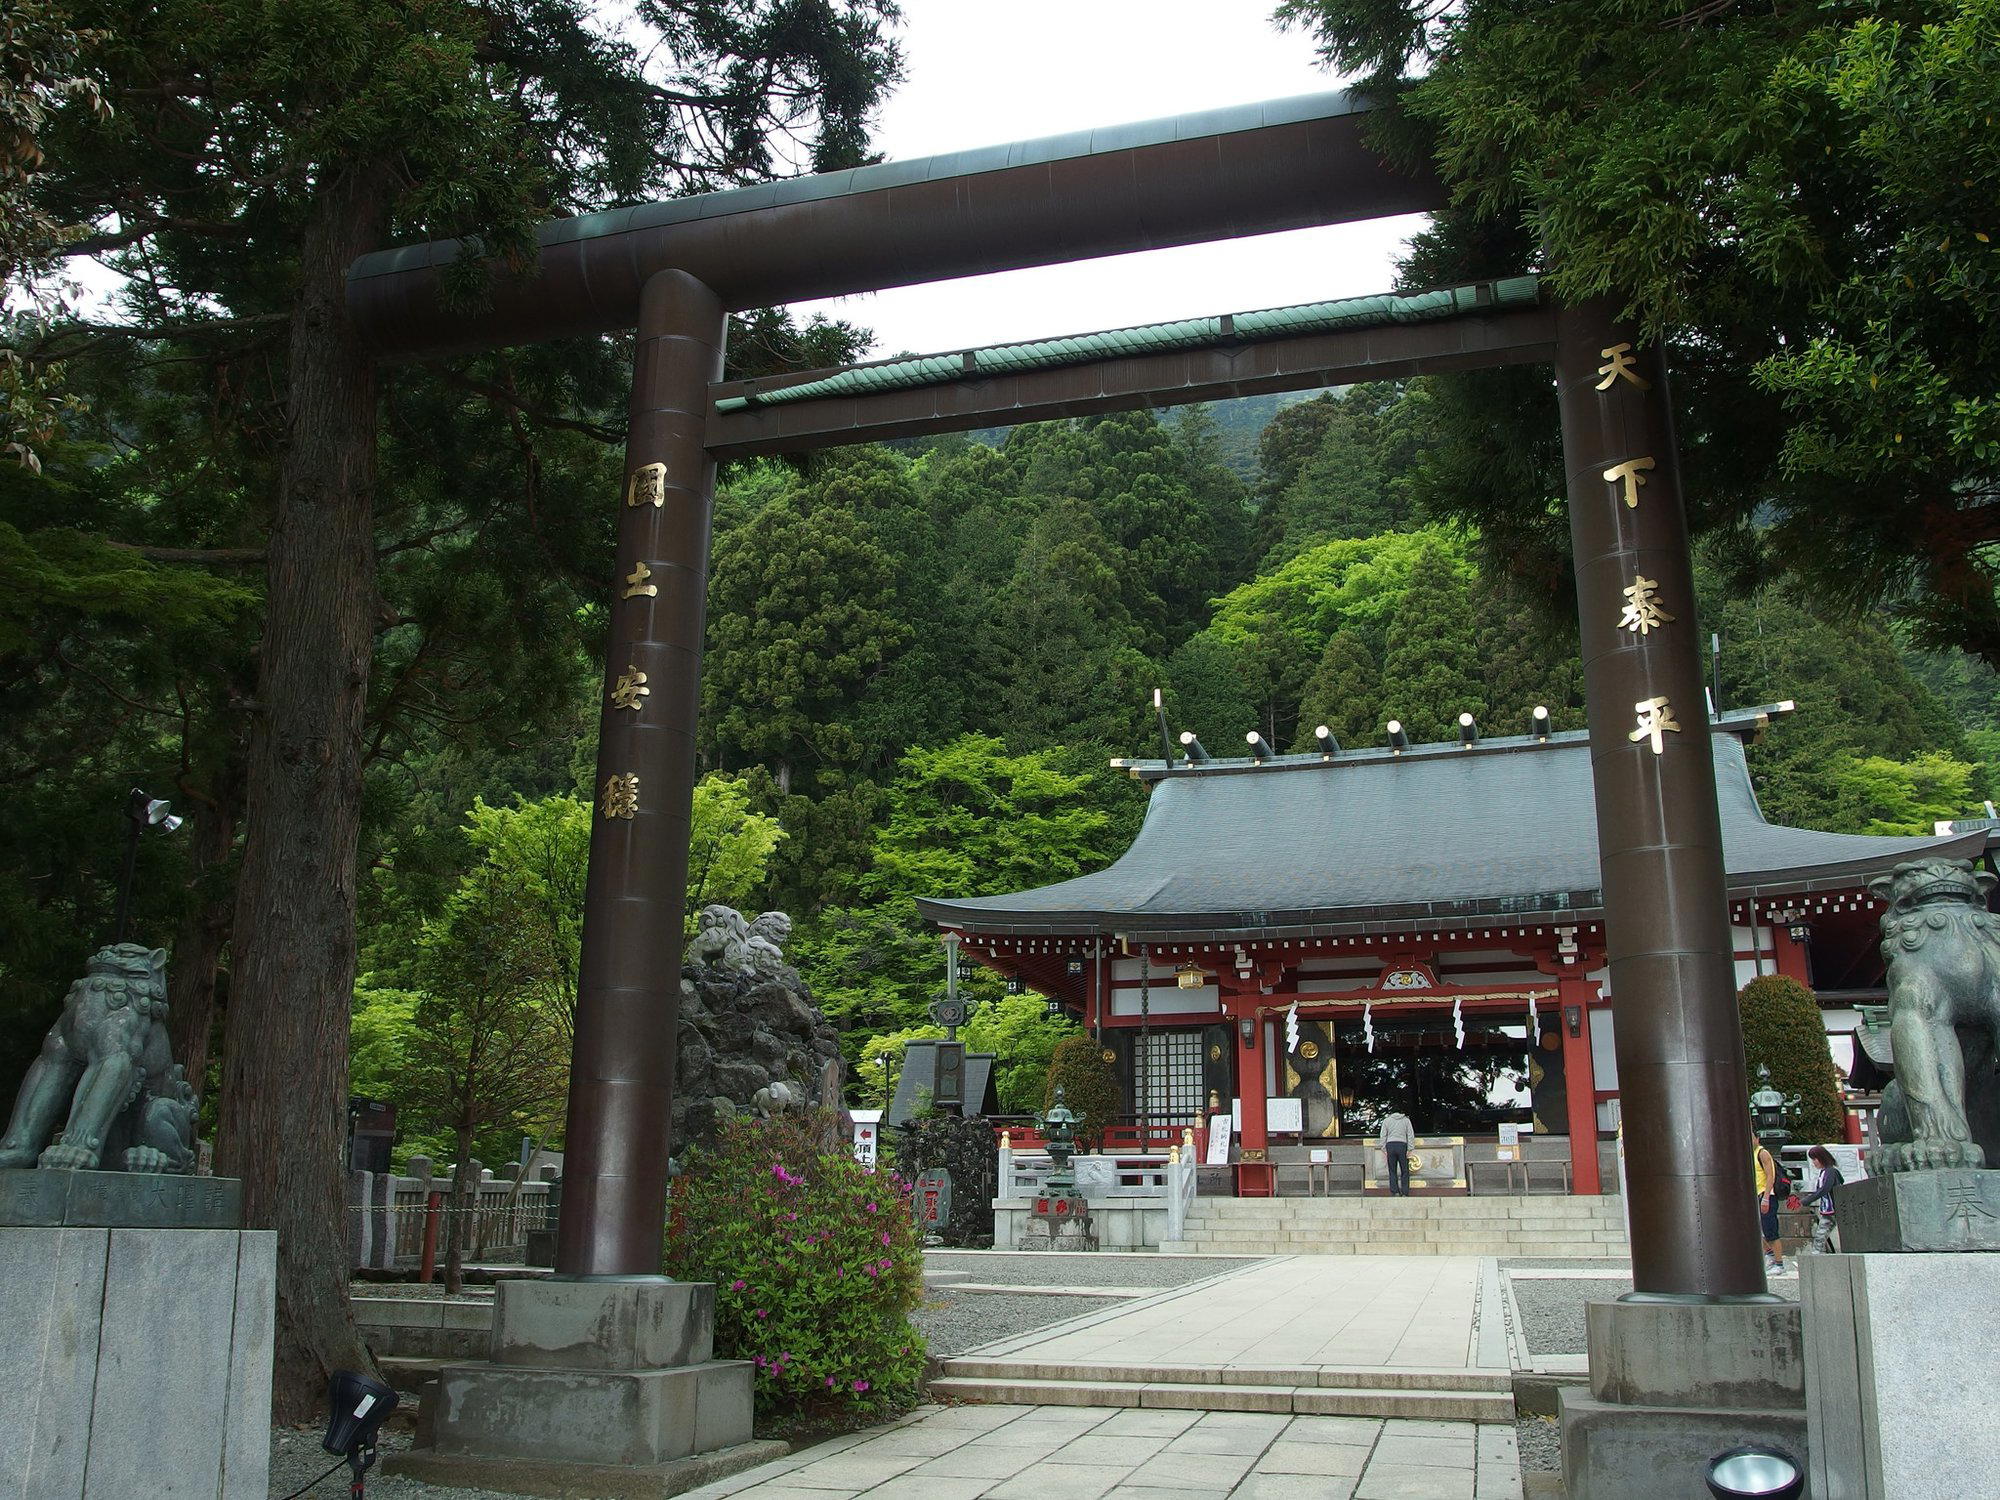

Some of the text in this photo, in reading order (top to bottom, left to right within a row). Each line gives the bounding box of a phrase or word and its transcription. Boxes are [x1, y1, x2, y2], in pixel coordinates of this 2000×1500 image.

[1596, 342, 1682, 755] 天下泰平
[1945, 1178, 1997, 1234] 奉
